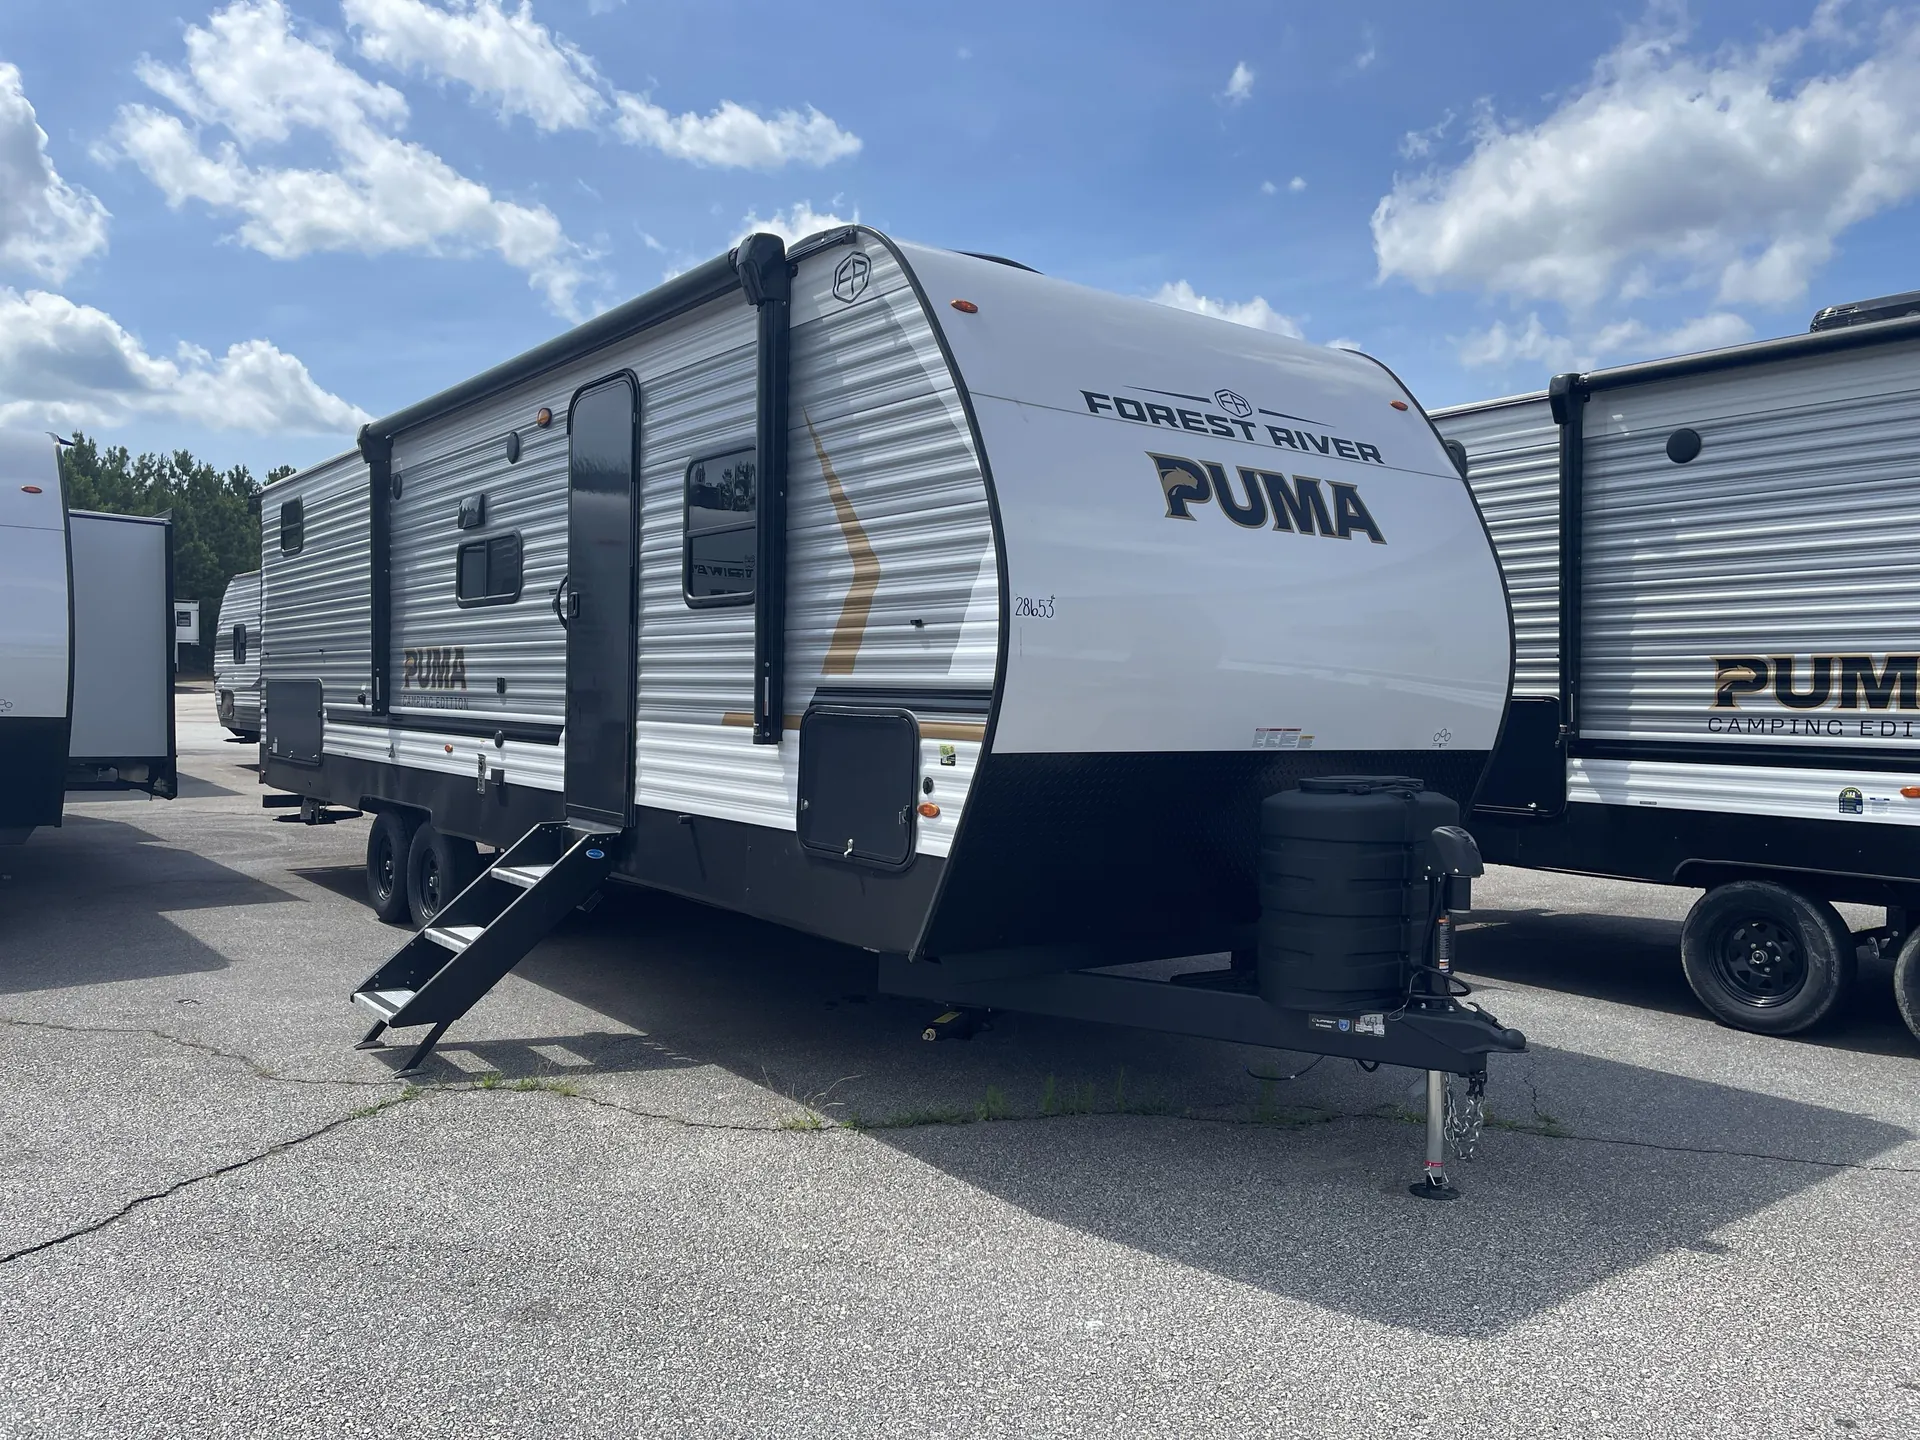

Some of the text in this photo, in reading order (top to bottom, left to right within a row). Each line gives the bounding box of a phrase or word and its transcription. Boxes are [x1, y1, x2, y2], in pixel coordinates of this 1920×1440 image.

[1079, 389, 1386, 465] FOREST RIVER
[1144, 451, 1387, 545] PUMA
[1015, 596, 1054, 618] 28653
[402, 646, 468, 691] PUMA
[401, 695, 469, 710] CAMPING EDITION
[1708, 717, 1914, 737] CAMPING EDI
